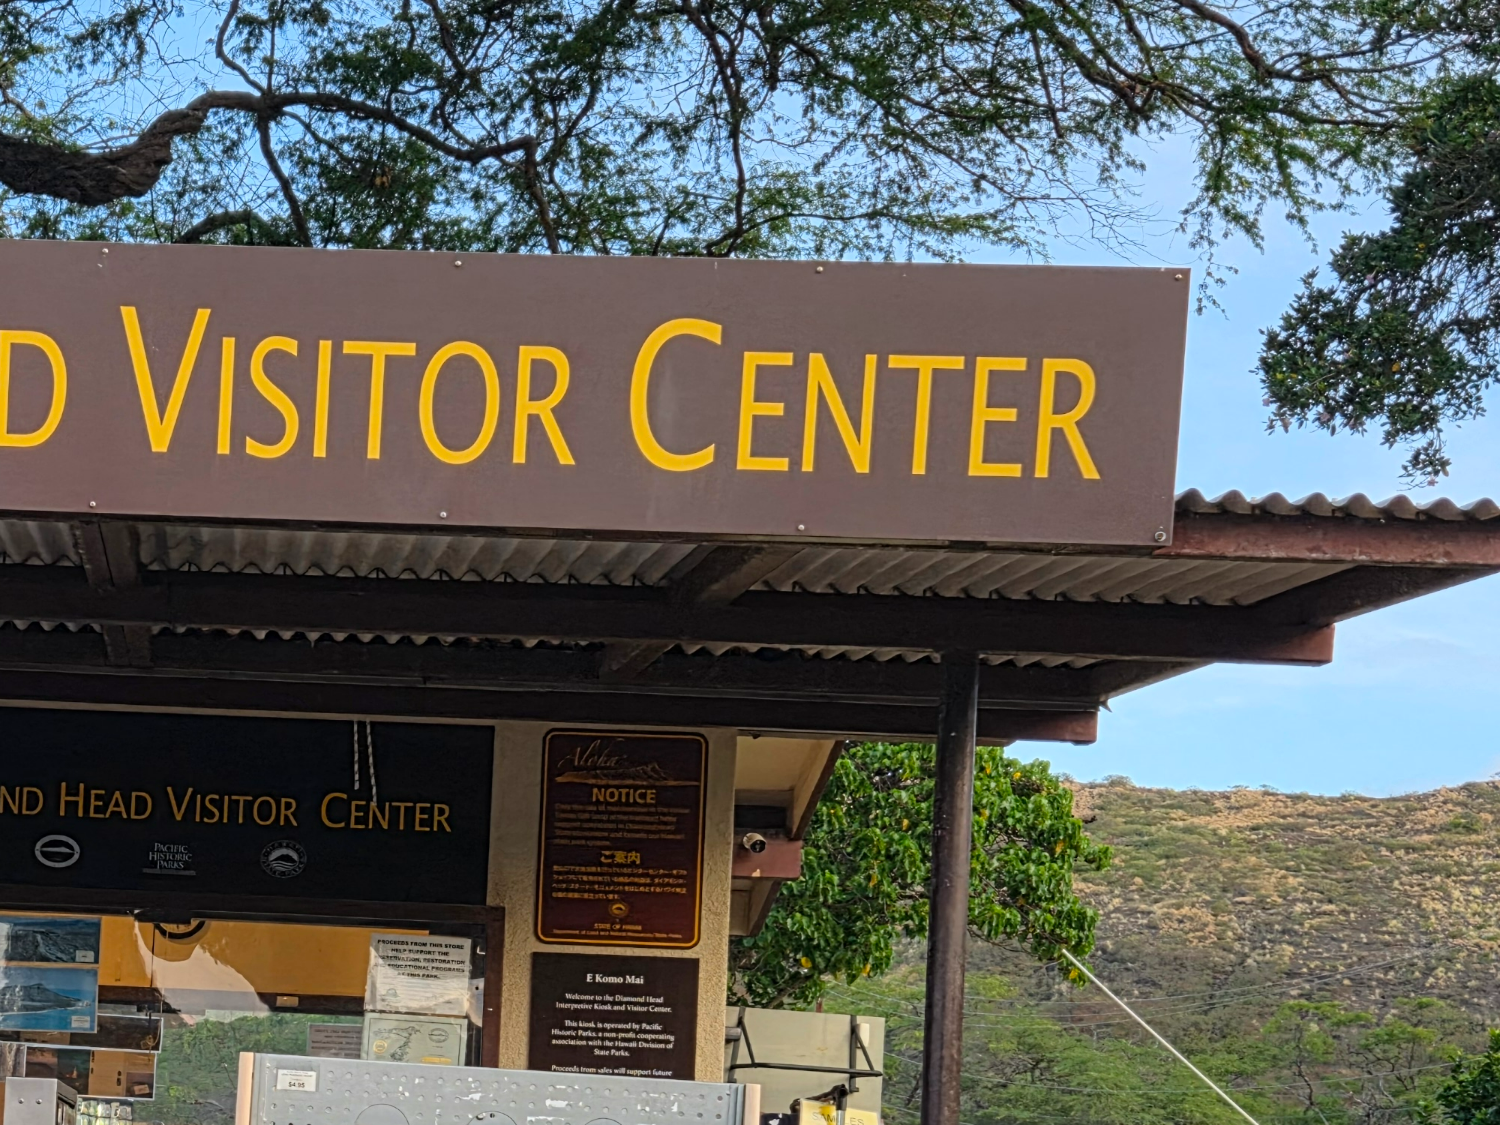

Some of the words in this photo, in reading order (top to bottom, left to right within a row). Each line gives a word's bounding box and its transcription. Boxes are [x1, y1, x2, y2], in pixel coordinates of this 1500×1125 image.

[119, 305, 576, 465] VISITOR
[628, 317, 1101, 481] CENTER
[592, 787, 657, 804] NOTICE
[59, 781, 152, 820] HEAD
[166, 786, 298, 827] VISITOR
[320, 792, 451, 832] CENTER
[154, 842, 188, 853] PACIFIC
[149, 851, 192, 862] HISTORIC
[156, 860, 184, 870] PARKS
[586, 974, 593, 983] E
[595, 974, 624, 984] Komo
[625, 975, 644, 984] Mai
[565, 993, 594, 1001] Welcome
[603, 994, 614, 1002] the
[615, 994, 645, 1002] Diamond
[556, 1002, 592, 1010] Interpretive
[626, 1004, 648, 1012] Visitor
[578, 1020, 596, 1028] kiosk
[604, 1022, 632, 1030] operated
[632, 1022, 640, 1031] by
[551, 1028, 576, 1036] Historic
[604, 1030, 636, 1039] non-profit
[636, 1033, 674, 1041] cooperating
[614, 1040, 636, 1048] Hawaii
[666, 1042, 674, 1050] of
[594, 1048, 610, 1056] State
[551, 1064, 580, 1072] Proceeds
[626, 1068, 652, 1076] support
